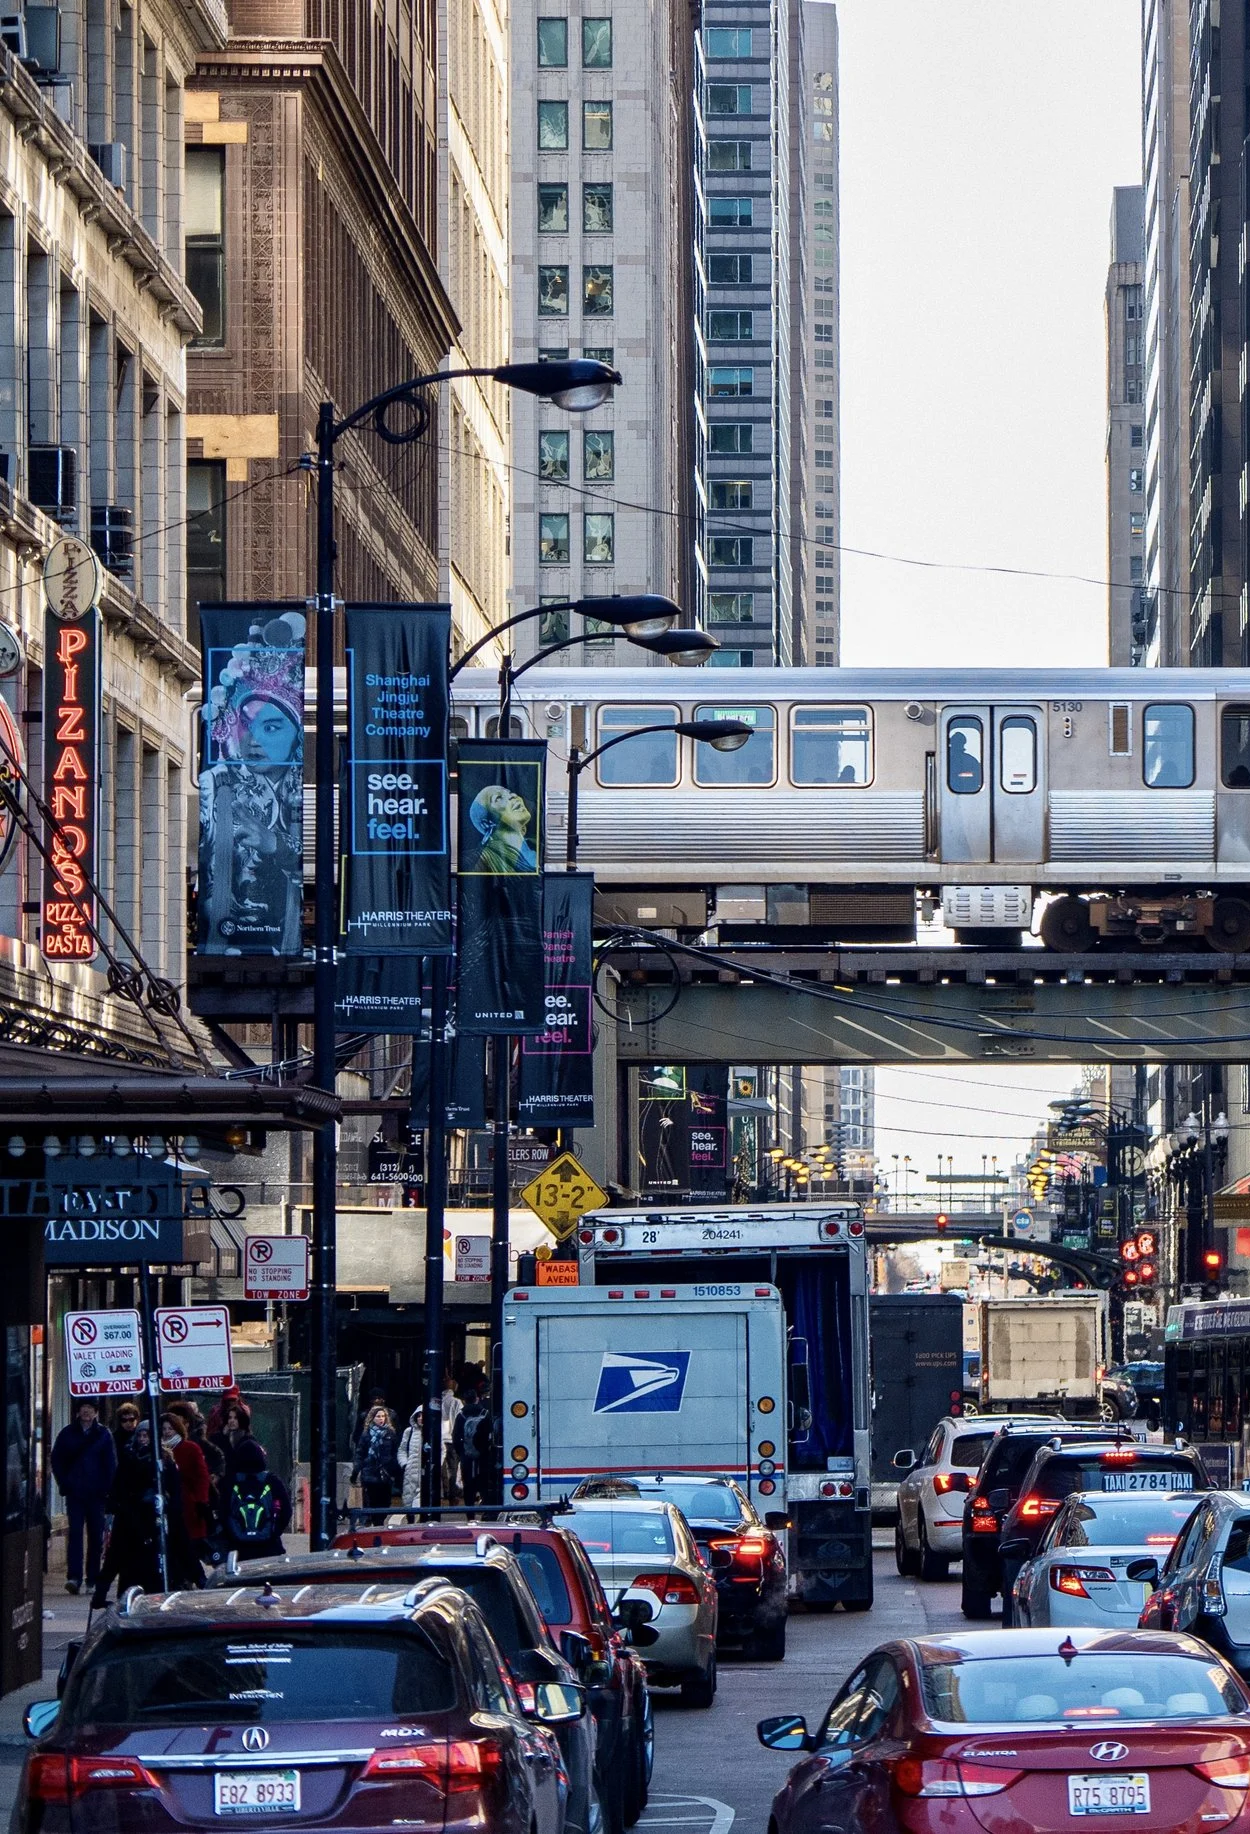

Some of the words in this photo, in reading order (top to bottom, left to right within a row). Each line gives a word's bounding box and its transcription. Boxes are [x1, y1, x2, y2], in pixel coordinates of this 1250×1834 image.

[61, 542, 81, 614] PIZZA
[365, 674, 430, 689] Shanghai
[377, 691, 419, 705] Jingju
[372, 707, 424, 719] Theatre
[1053, 702, 1083, 713] 5130
[365, 724, 431, 738] Company
[367, 773, 419, 790] see.
[367, 794, 428, 814] hear.
[367, 818, 420, 839] feel.
[46, 903, 90, 926] PIZZA
[362, 911, 403, 921] HARRIS
[404, 911, 451, 921] THEATER
[236, 924, 264, 932] Northern
[264, 924, 281, 932] Trust
[46, 935, 91, 953] PASTA
[543, 955, 576, 963] heatre
[346, 995, 381, 1005] HARRIS
[382, 996, 422, 1006] THEATER
[544, 995, 572, 1008] ee.
[545, 1012, 578, 1025] ear.
[528, 1095, 560, 1103] HARRIS
[560, 1094, 594, 1102] THEATER
[691, 1131, 714, 1141] see.
[691, 1141, 718, 1151] hear.
[508, 1149, 530, 1160] ELERS
[531, 1148, 550, 1160] ROW
[691, 1152, 714, 1161] feel.
[370, 1172, 409, 1181] 641-5600
[535, 1184, 594, 1209] 13'-2"
[642, 1230, 660, 1243] 28'
[702, 1230, 741, 1240] 204241
[546, 1265, 577, 1273] WABAS
[546, 1276, 577, 1284] AVENU
[252, 1291, 269, 1299] TOW
[277, 1291, 300, 1299] ZONE
[693, 1285, 741, 1296] 1510853
[103, 1331, 132, 1340] $67.00
[72, 1351, 97, 1360] VALET
[100, 1350, 134, 1359] LOADING
[109, 1364, 131, 1374] LAZ
[75, 1382, 100, 1393] TOW
[106, 1380, 138, 1392] ZONE
[168, 1378, 190, 1390] TOW
[198, 1377, 225, 1389] ZONE
[1104, 1475, 1125, 1490] TAXI
[1129, 1474, 1167, 1489] 2784
[1171, 1474, 1193, 1489] TAXI
[380, 1728, 426, 1737] MDX
[220, 1784, 248, 1804] E82
[256, 1783, 295, 1803] 8933
[1073, 1787, 1100, 1807] R75
[1110, 1786, 1145, 1805] 8795
